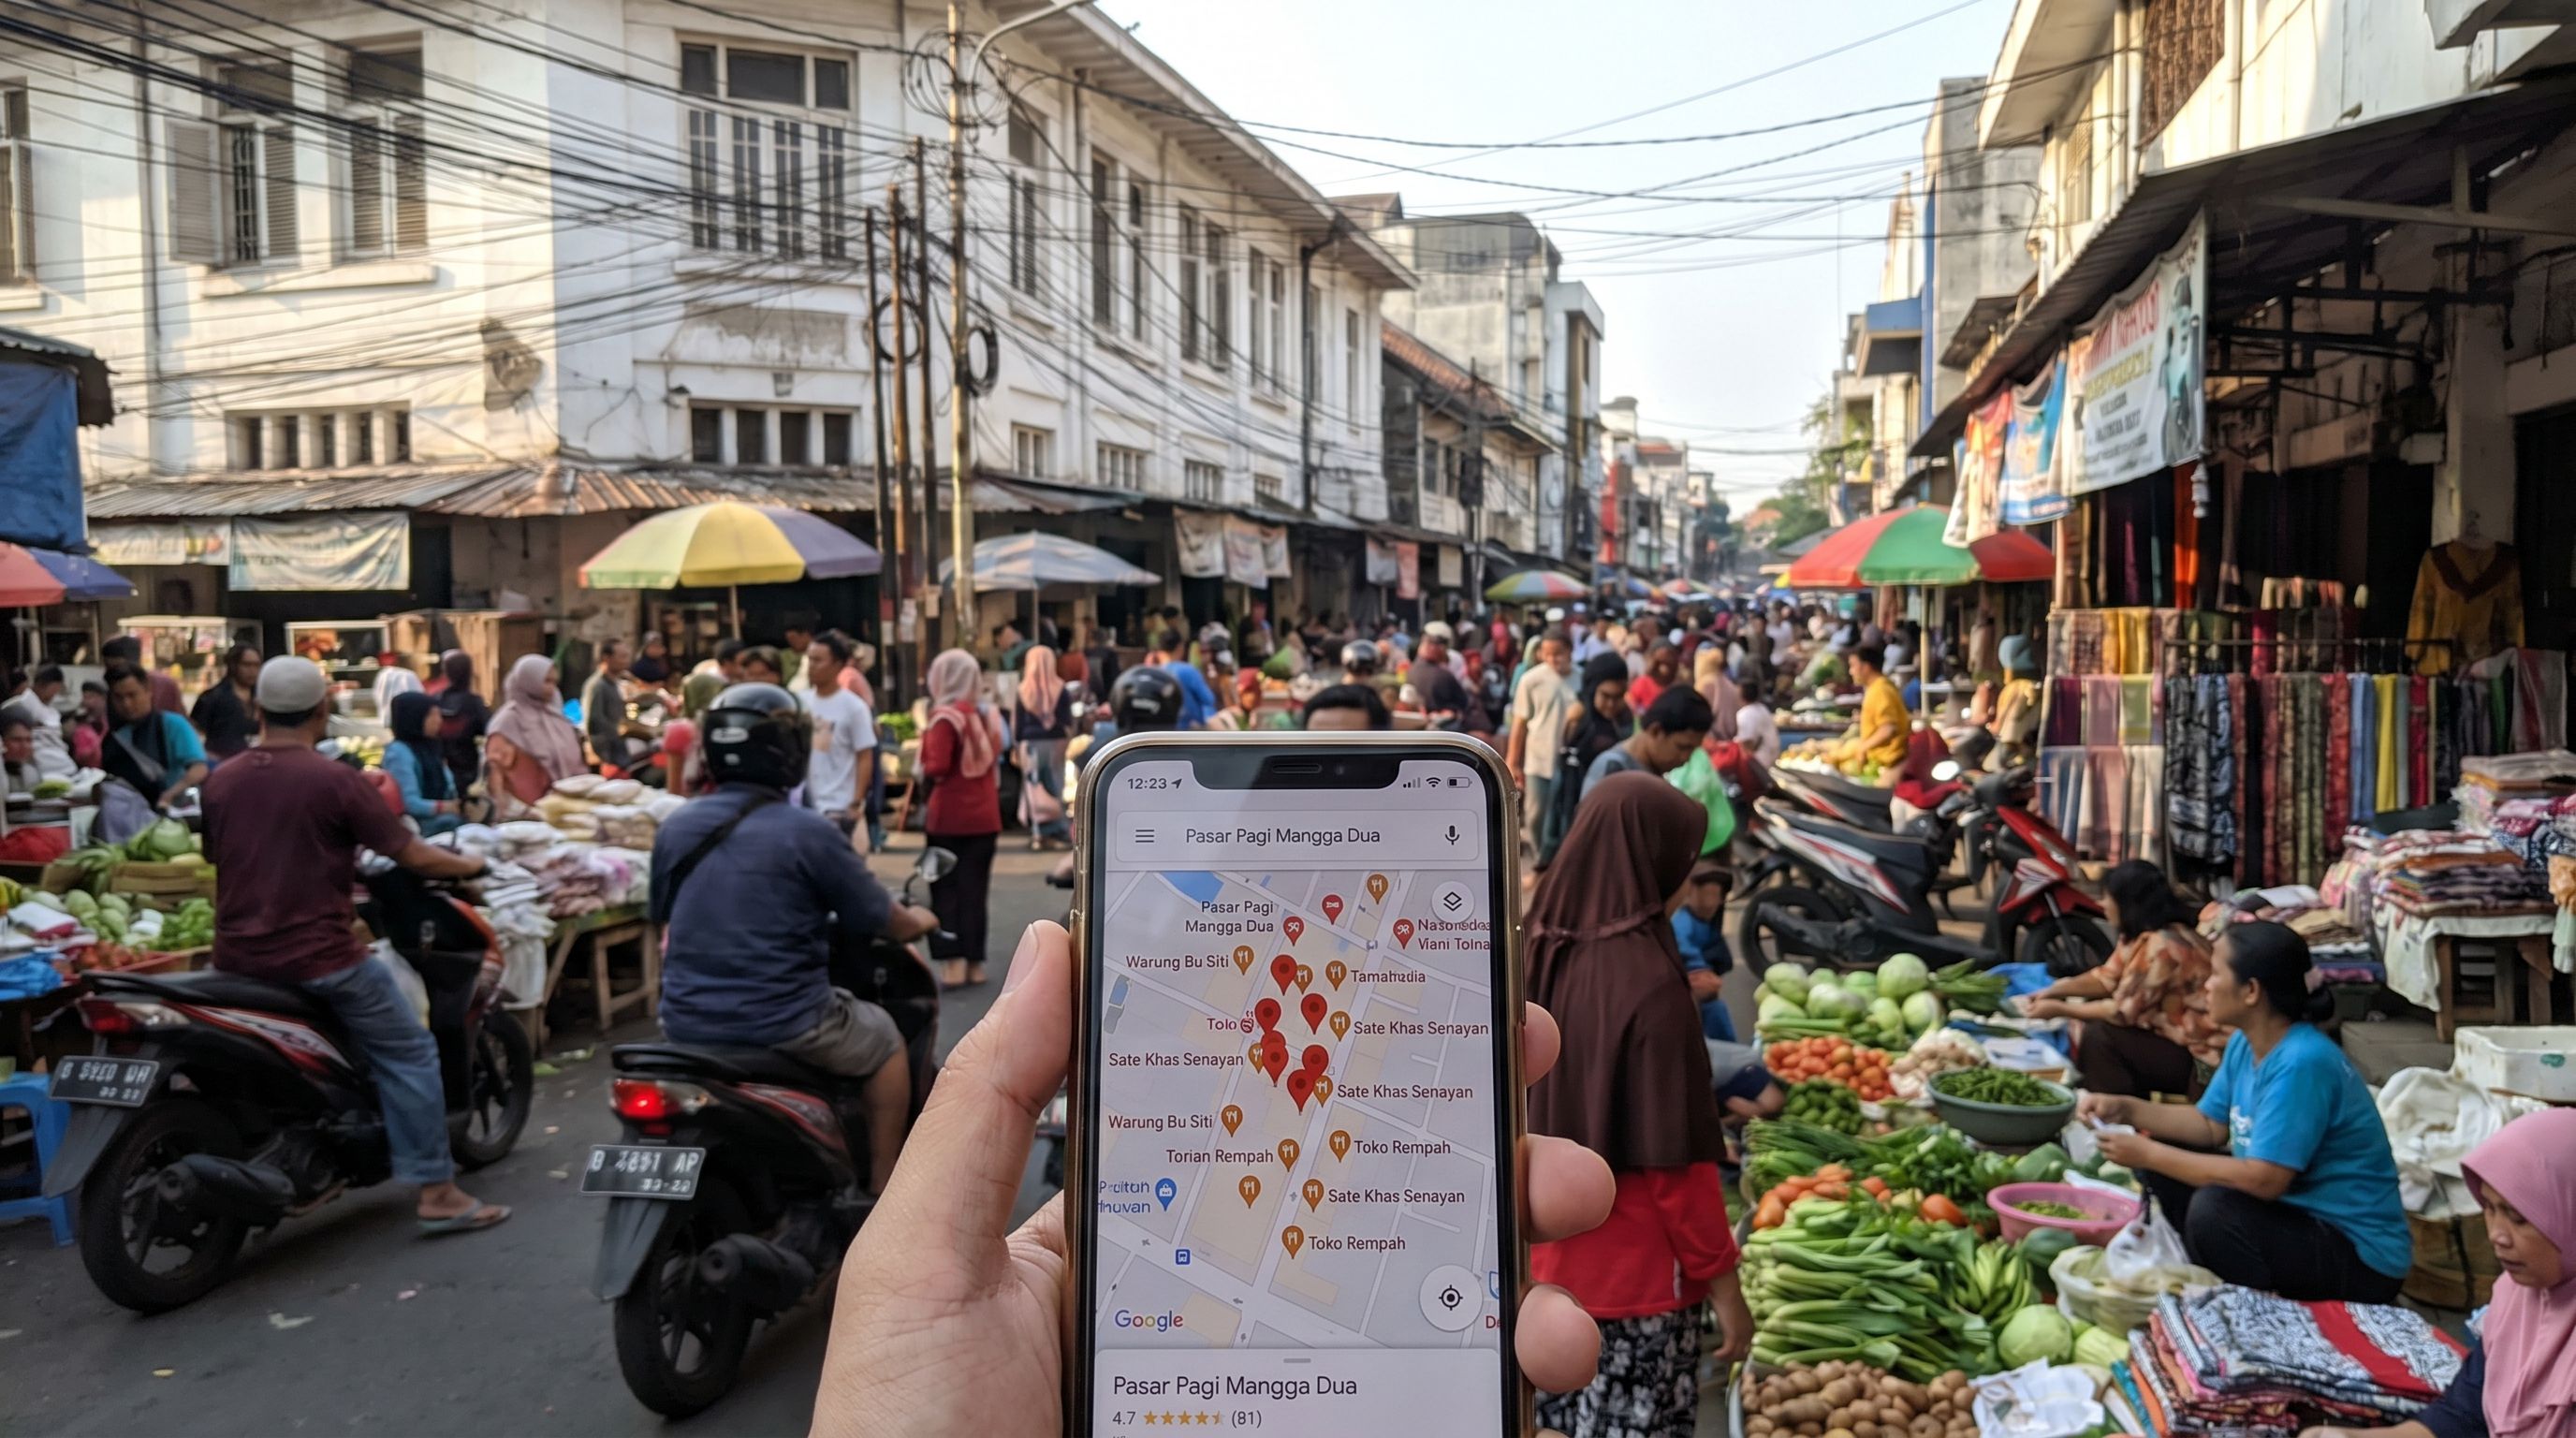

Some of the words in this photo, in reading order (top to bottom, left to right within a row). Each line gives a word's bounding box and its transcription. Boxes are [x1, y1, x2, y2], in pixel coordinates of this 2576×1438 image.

[1128, 778, 1166, 789] 12:23
[1187, 829, 1232, 843] Pasar
[1237, 829, 1270, 846] Pagi
[1277, 829, 1342, 845] Mangga
[1349, 829, 1380, 842] Dua
[1202, 902, 1239, 913] Pasar
[1245, 901, 1273, 916] Pagi
[1186, 920, 1241, 935] Mangga
[1247, 920, 1273, 932] Dua
[1126, 956, 1179, 971] Warung
[1185, 956, 1202, 967] Bu
[1207, 955, 1228, 967] Siti
[1354, 1021, 1384, 1034] Sate
[1390, 1021, 1424, 1034] Khas
[1428, 1021, 1488, 1037] Senayan
[1109, 1053, 1140, 1065] Sate
[1146, 1053, 1178, 1065] Khas
[1184, 1053, 1243, 1069] Senayan
[1338, 1085, 1368, 1097] Sate
[1374, 1085, 1407, 1097] Khas
[1412, 1085, 1472, 1101] Senayan
[1109, 1116, 1163, 1132] Warung
[1168, 1115, 1186, 1128] Bu
[1191, 1115, 1212, 1128] Siti
[1354, 1140, 1387, 1153] Toko
[1393, 1140, 1450, 1157] Rempah
[1166, 1150, 1209, 1163] Torian
[1216, 1150, 1273, 1166] Rempah
[1329, 1190, 1360, 1202] Sate
[1366, 1189, 1399, 1202] Khas
[1404, 1189, 1464, 1206] Senayan
[1309, 1236, 1342, 1250] Toko
[1348, 1237, 1405, 1253] Rempah
[1115, 1310, 1182, 1332] Google
[1115, 1376, 1170, 1394] Pasar
[1178, 1376, 1219, 1400] Pagi
[1227, 1376, 1310, 1400] Mangga
[1318, 1376, 1356, 1394] Dua
[1113, 1412, 1135, 1424] 4.7
[1232, 1411, 1261, 1428] (81)
